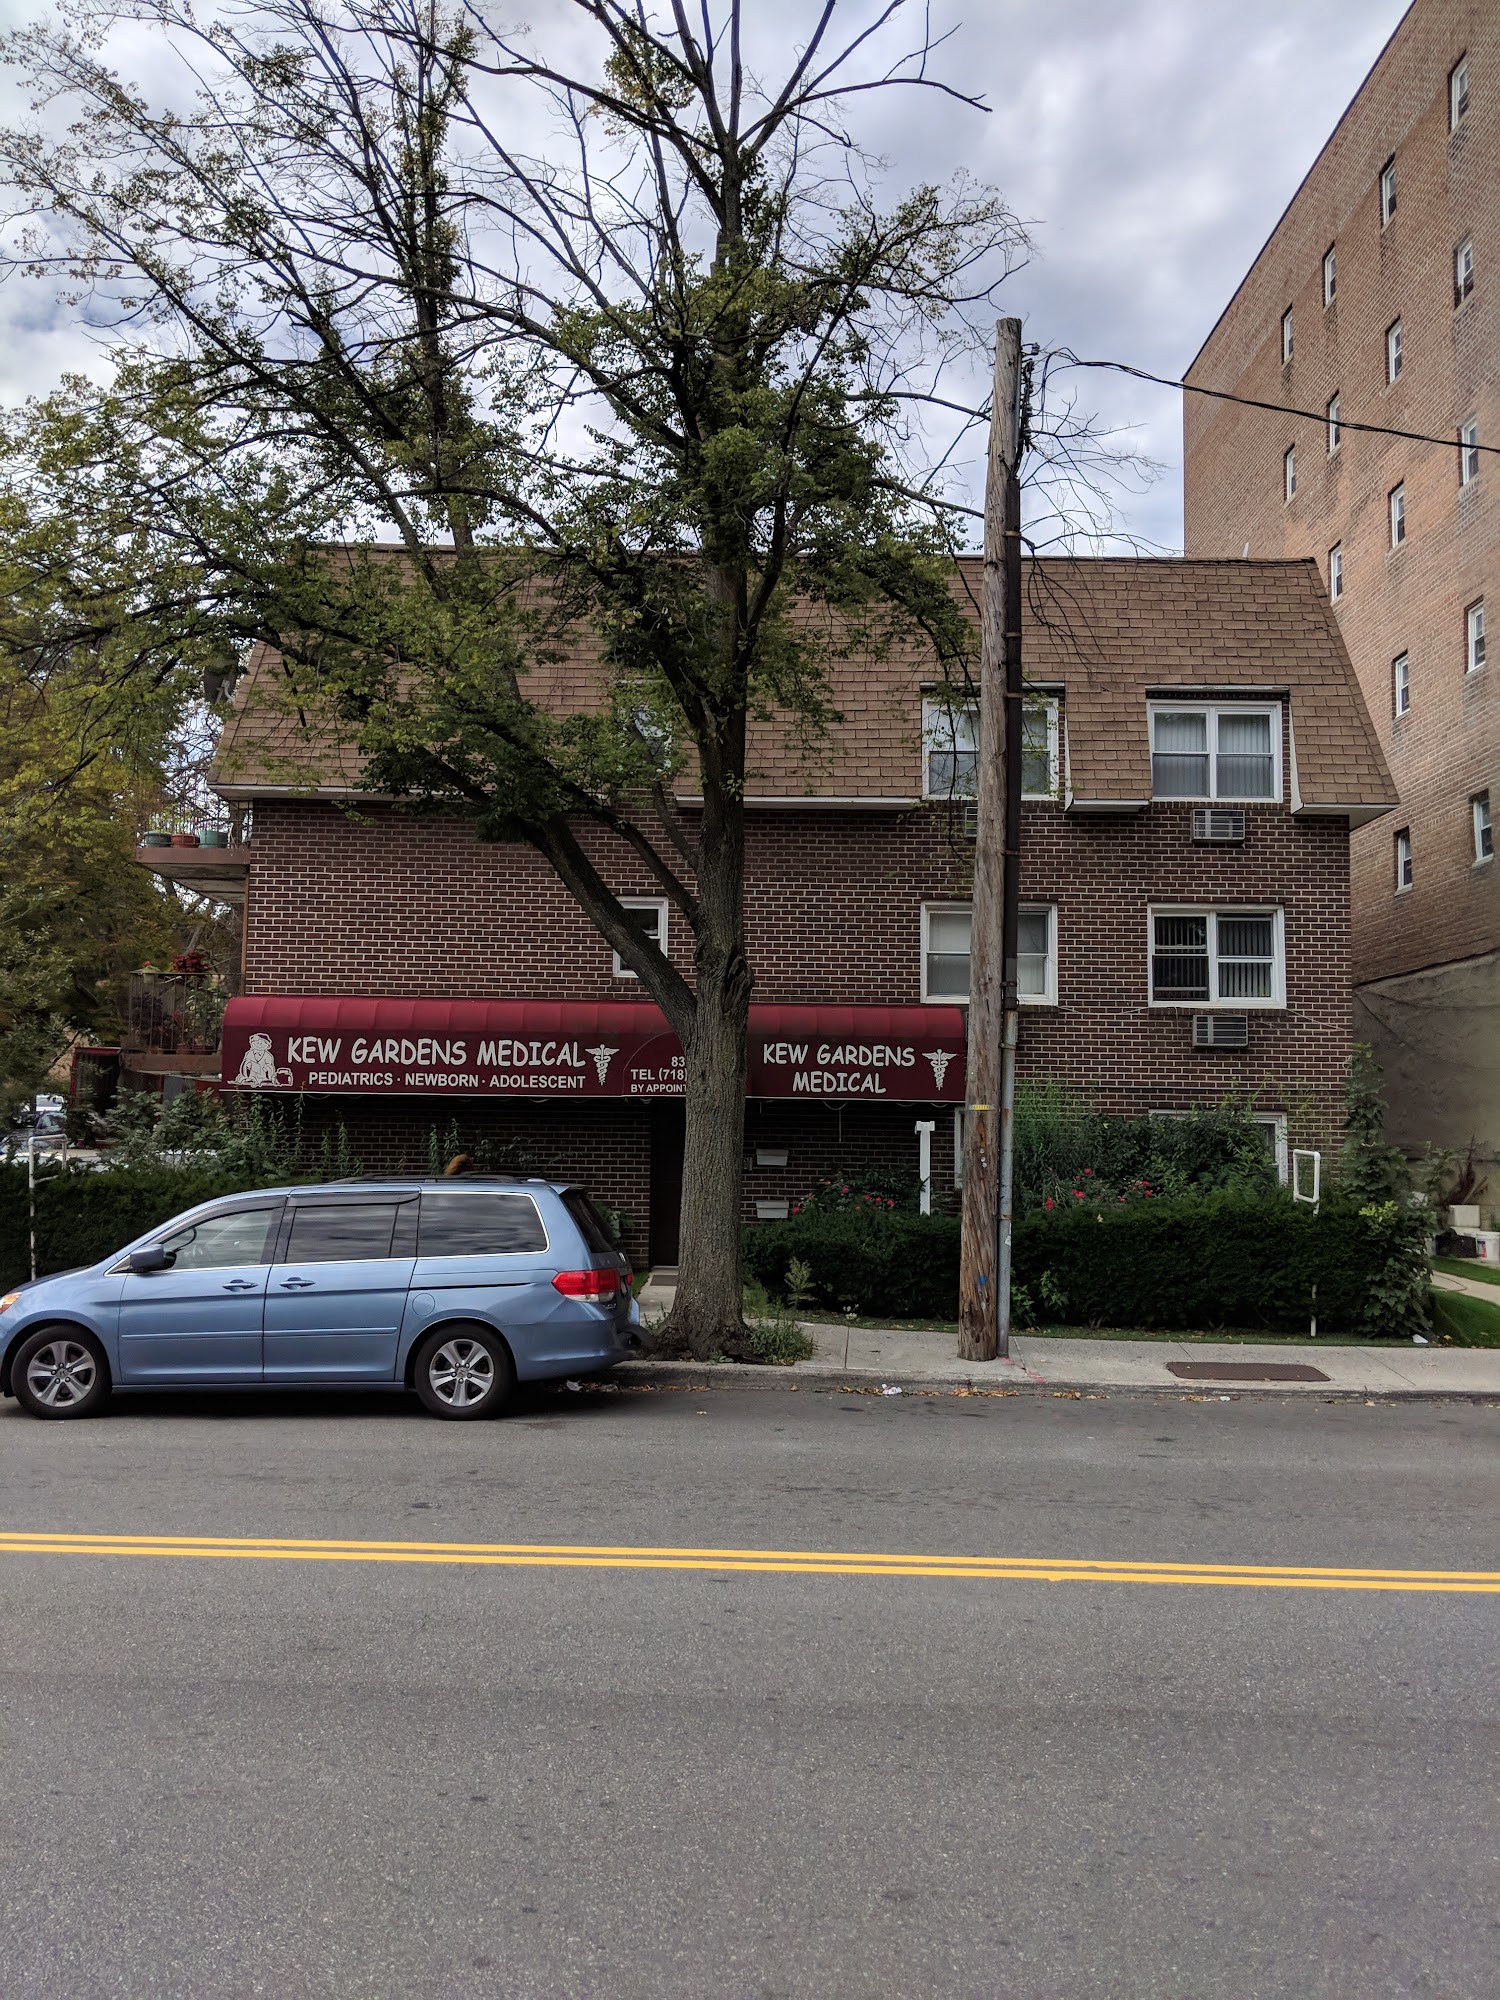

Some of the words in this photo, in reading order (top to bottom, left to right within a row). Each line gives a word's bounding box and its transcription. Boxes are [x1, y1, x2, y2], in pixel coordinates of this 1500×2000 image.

[287, 1036, 342, 1064] KEW
[351, 1037, 467, 1065] GARDENS
[476, 1039, 586, 1067] MEDICAL
[763, 1042, 809, 1064] KEW
[816, 1044, 915, 1067] GARDENS
[308, 1071, 394, 1086] PEDIATRICS
[405, 1072, 479, 1087] NEWBORN
[489, 1074, 586, 1089] ADOLESCENT
[630, 1069, 656, 1080] TEL
[658, 1067, 688, 1081] (718)
[792, 1071, 887, 1094] MEDICAL
[630, 1084, 645, 1093] BY
